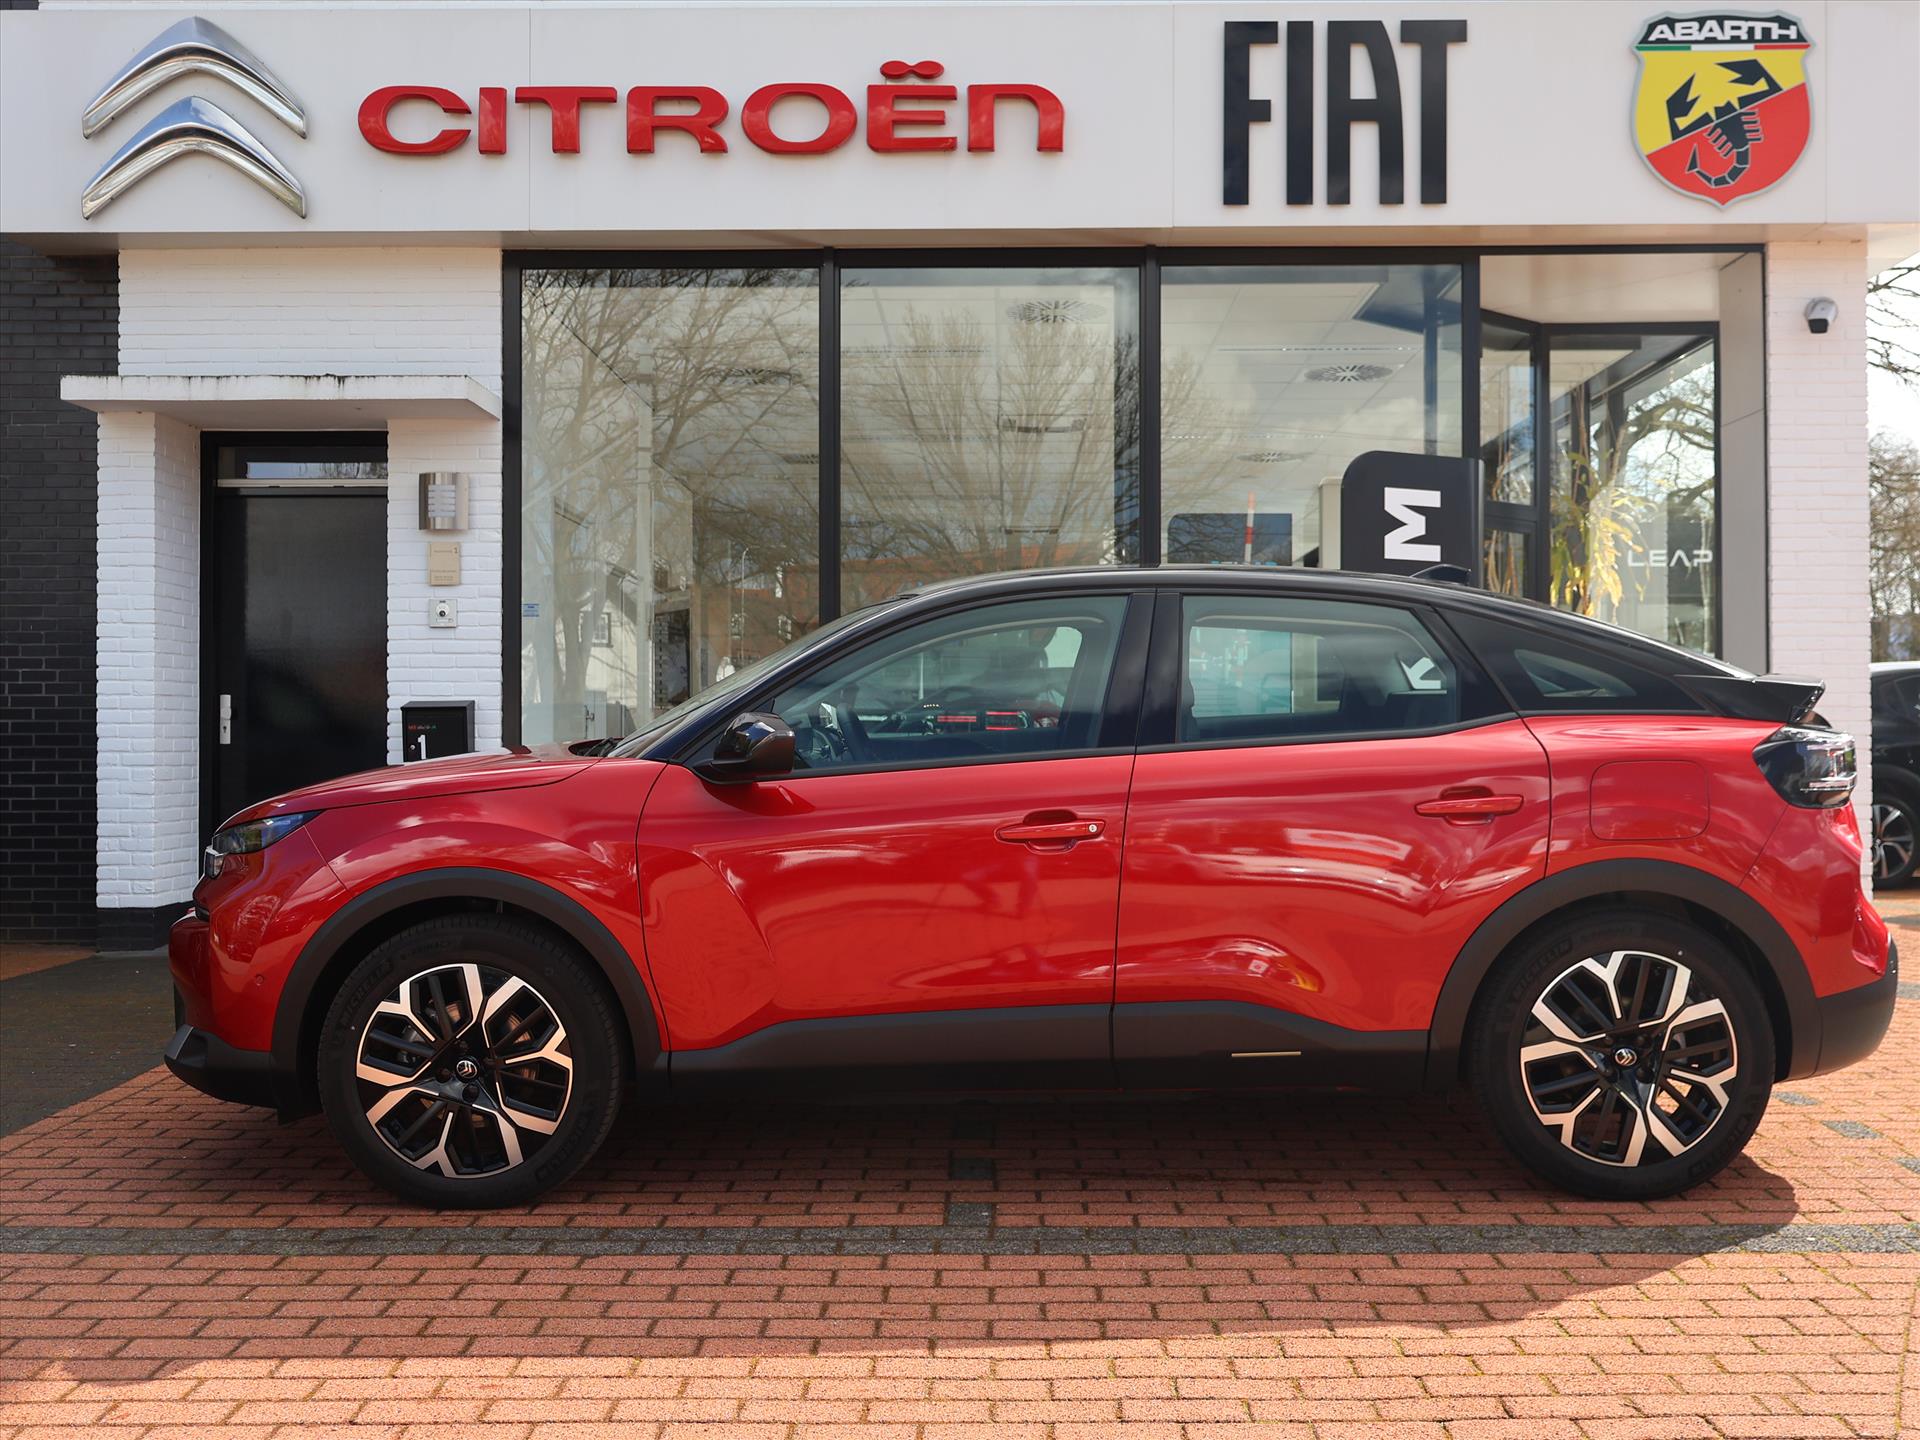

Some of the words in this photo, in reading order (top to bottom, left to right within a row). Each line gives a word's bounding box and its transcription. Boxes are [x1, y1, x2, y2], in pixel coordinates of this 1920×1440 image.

[1648, 19, 1798, 42] ABARTH
[357, 59, 1065, 156] CITROËN
[1223, 19, 1468, 206] FIAT
[1627, 549, 1714, 567] LEAP
[417, 734, 427, 760] 1
